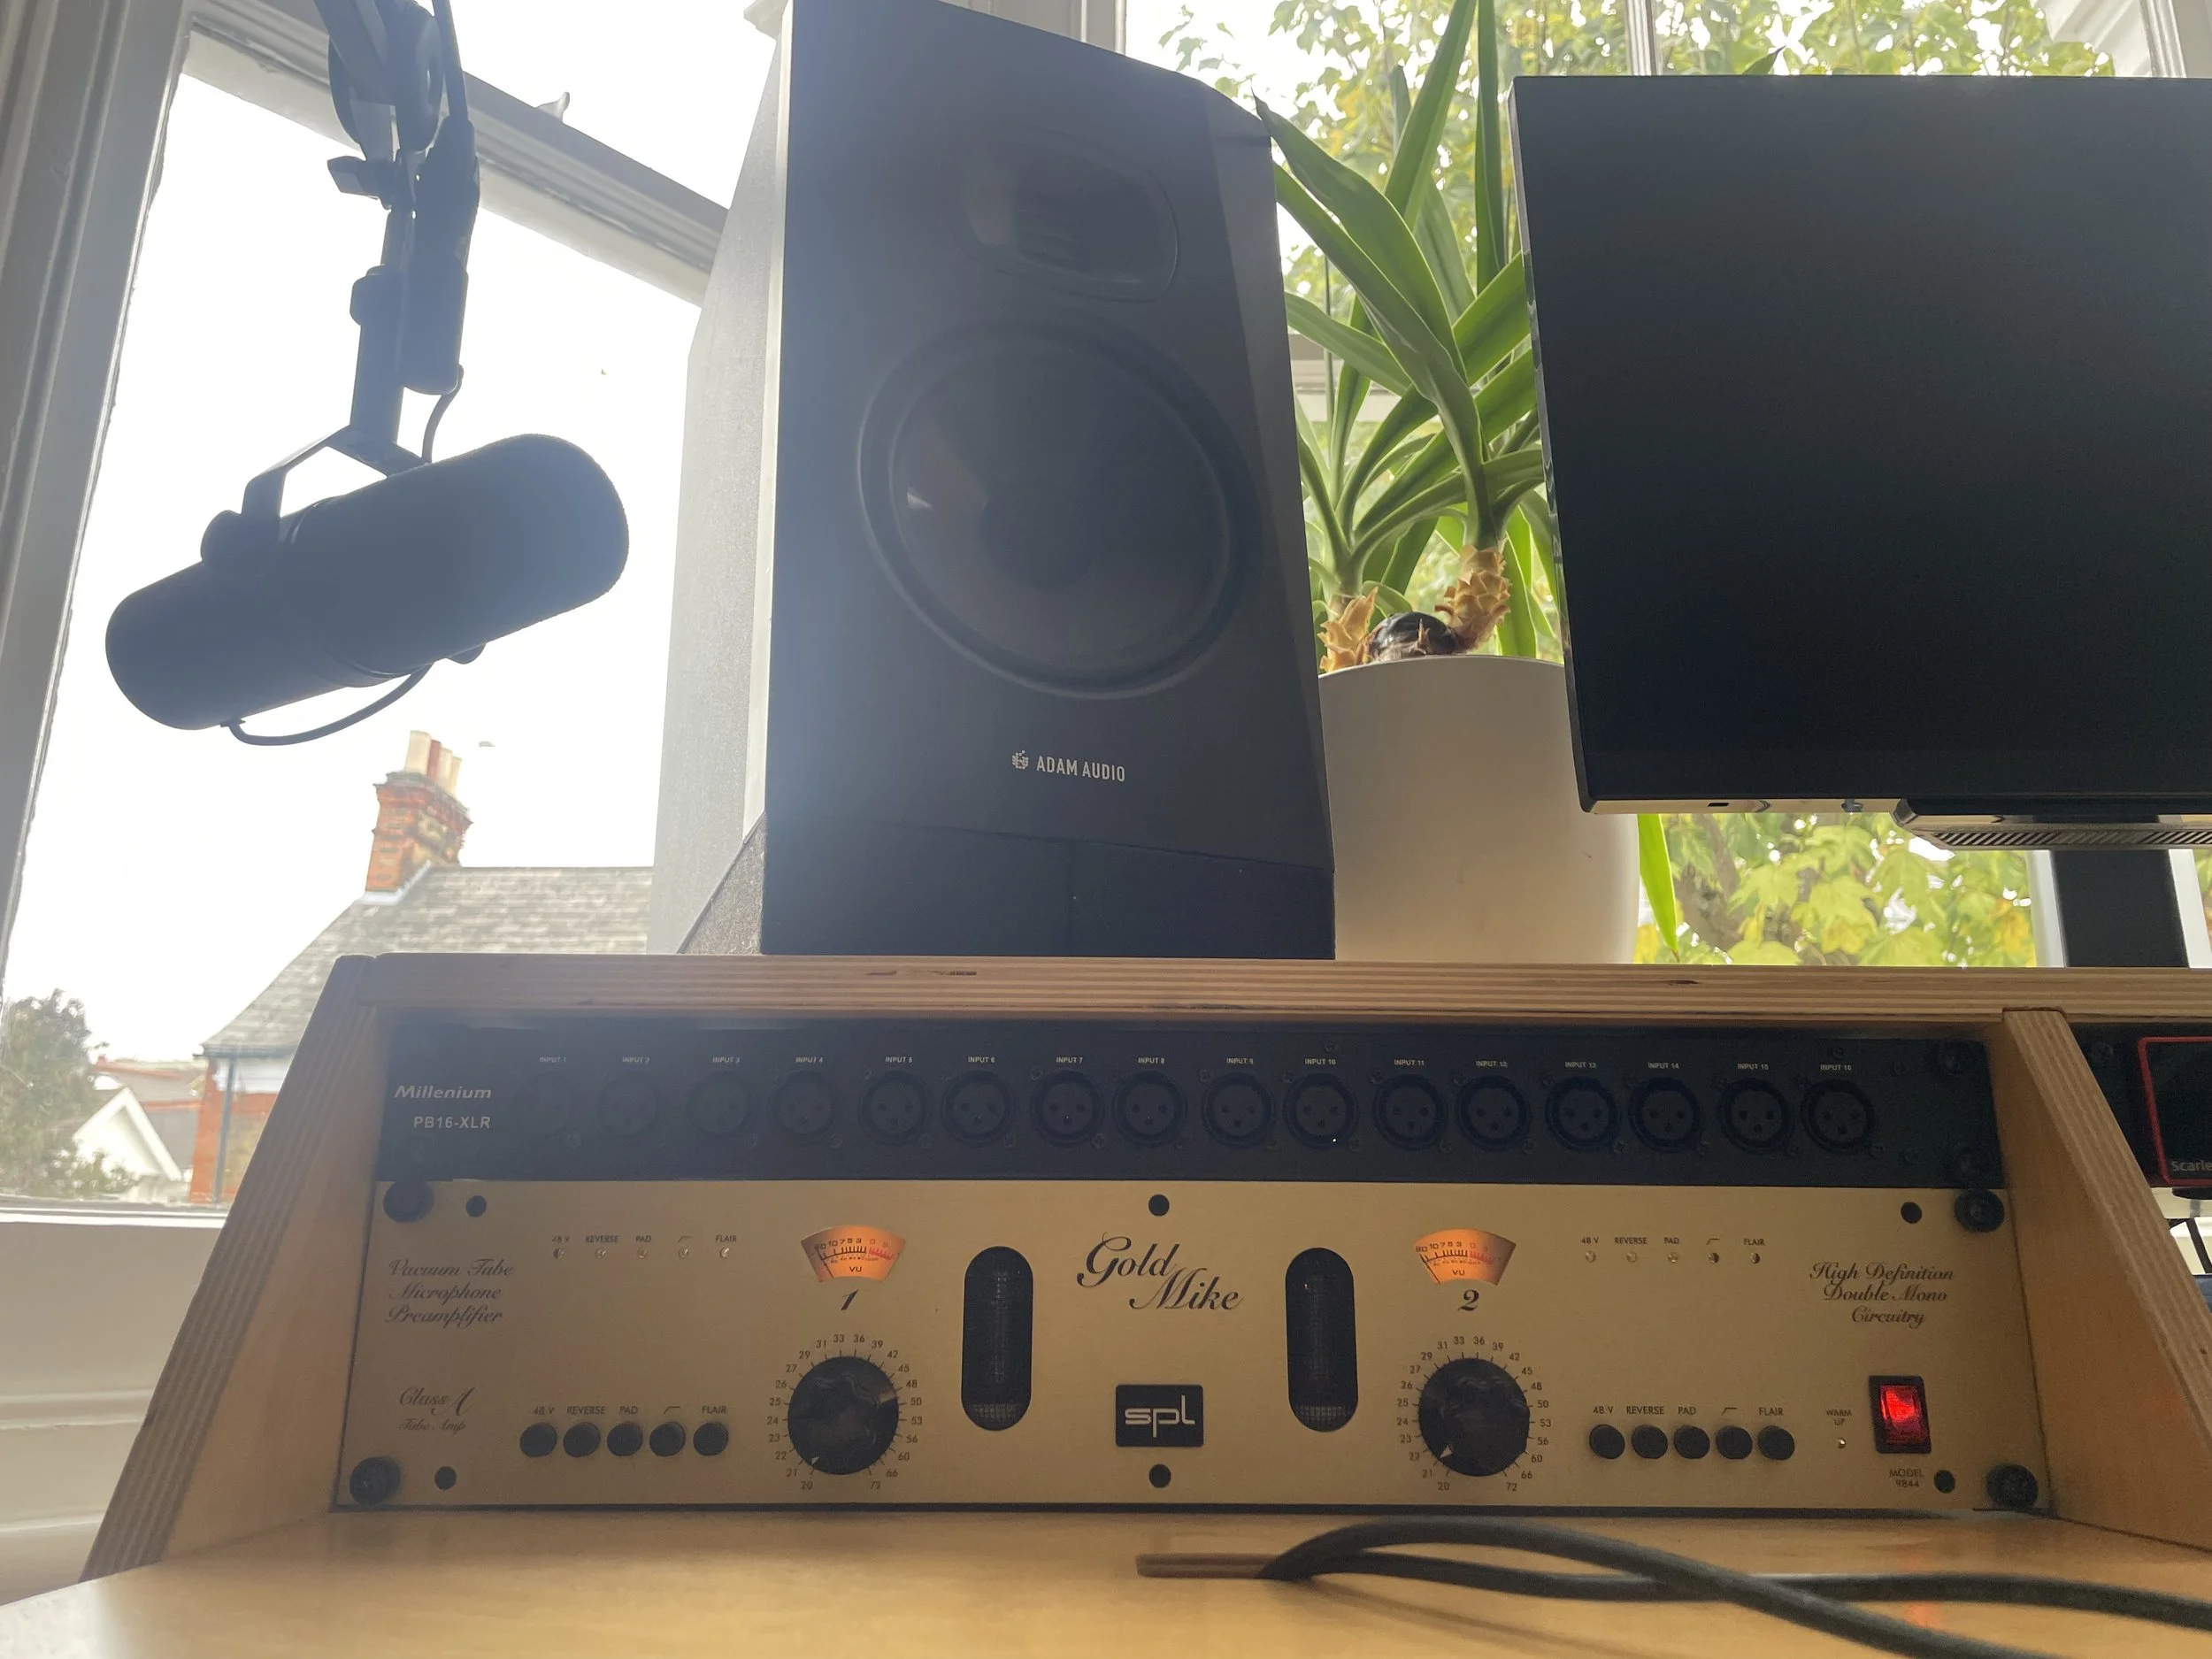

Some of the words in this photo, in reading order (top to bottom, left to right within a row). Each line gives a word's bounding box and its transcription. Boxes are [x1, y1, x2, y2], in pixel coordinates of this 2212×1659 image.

[1036, 755, 1078, 776] ADAM
[1081, 761, 1125, 782] AUDIO
[395, 1085, 492, 1099] Millenium
[413, 1116, 491, 1129] PB16-XLR
[1077, 1232, 1179, 1287] Gold
[388, 1259, 460, 1277] Vacuum
[466, 1257, 514, 1277] Tube
[1809, 1261, 1859, 1286] High
[1865, 1262, 1954, 1286] Definition
[1128, 1265, 1244, 1310] Mike
[1824, 1280, 1890, 1302] Double
[1891, 1283, 1947, 1302] Mono
[388, 1282, 503, 1305] Microphone
[841, 1289, 859, 1311] 1
[1458, 1289, 1479, 1311] 2
[384, 1305, 503, 1329] Preamplifier
[1851, 1305, 1925, 1329] Circuitry
[833, 1333, 845, 1343] 33
[853, 1333, 865, 1344] 36
[1453, 1335, 1465, 1346] 33
[1472, 1336, 1486, 1346] 36
[816, 1340, 827, 1348] 31
[871, 1340, 884, 1349] 39
[1437, 1340, 1448, 1350] 31
[1492, 1340, 1504, 1351] 39
[798, 1350, 811, 1360] 29
[887, 1349, 899, 1359] 42
[1420, 1351, 1432, 1361] 29
[1509, 1352, 1520, 1362] 42
[785, 1363, 797, 1373] 27
[897, 1363, 910, 1372] 45
[1409, 1365, 1421, 1374] 27
[1521, 1366, 1533, 1375] 45
[775, 1379, 787, 1389] 26
[905, 1379, 918, 1388] 48
[1401, 1380, 1413, 1390] 26
[1531, 1381, 1543, 1391] 48
[399, 1386, 448, 1406] Class
[769, 1397, 781, 1407] 25
[910, 1397, 922, 1406] 50
[1396, 1398, 1409, 1407] 25
[1537, 1399, 1549, 1409] 50
[534, 1406, 545, 1416] 48
[548, 1406, 555, 1416] V
[566, 1406, 607, 1416] REVERSE
[619, 1405, 639, 1416] PAD
[702, 1405, 727, 1415] FLAIR
[1593, 1406, 1604, 1415] 48
[1608, 1406, 1614, 1415] V
[1626, 1406, 1664, 1415] REVERSE
[1678, 1406, 1696, 1415] PAD
[1758, 1407, 1784, 1416] FLAIR
[766, 1416, 779, 1425] 24
[1125, 1394, 1195, 1438] spl
[1396, 1417, 1409, 1425] 24
[399, 1417, 430, 1432] Tube
[430, 1417, 468, 1435] Amp
[1540, 1418, 1552, 1428] 53
[768, 1433, 780, 1443] 23
[905, 1435, 918, 1444] 56
[1400, 1434, 1412, 1444] 23
[1537, 1436, 1549, 1446] 56
[775, 1451, 787, 1461] 22
[897, 1452, 910, 1462] 60
[1531, 1455, 1543, 1463] 60
[787, 1468, 797, 1478] 21
[886, 1469, 898, 1478] 66
[1422, 1469, 1432, 1479] 21
[1521, 1470, 1533, 1479] 66
[1889, 1468, 1924, 1478] MODEL
[870, 1480, 881, 1490] 72
[1437, 1482, 1450, 1491] 20
[1506, 1482, 1517, 1492] 72
[1895, 1479, 1919, 1488] 9844
